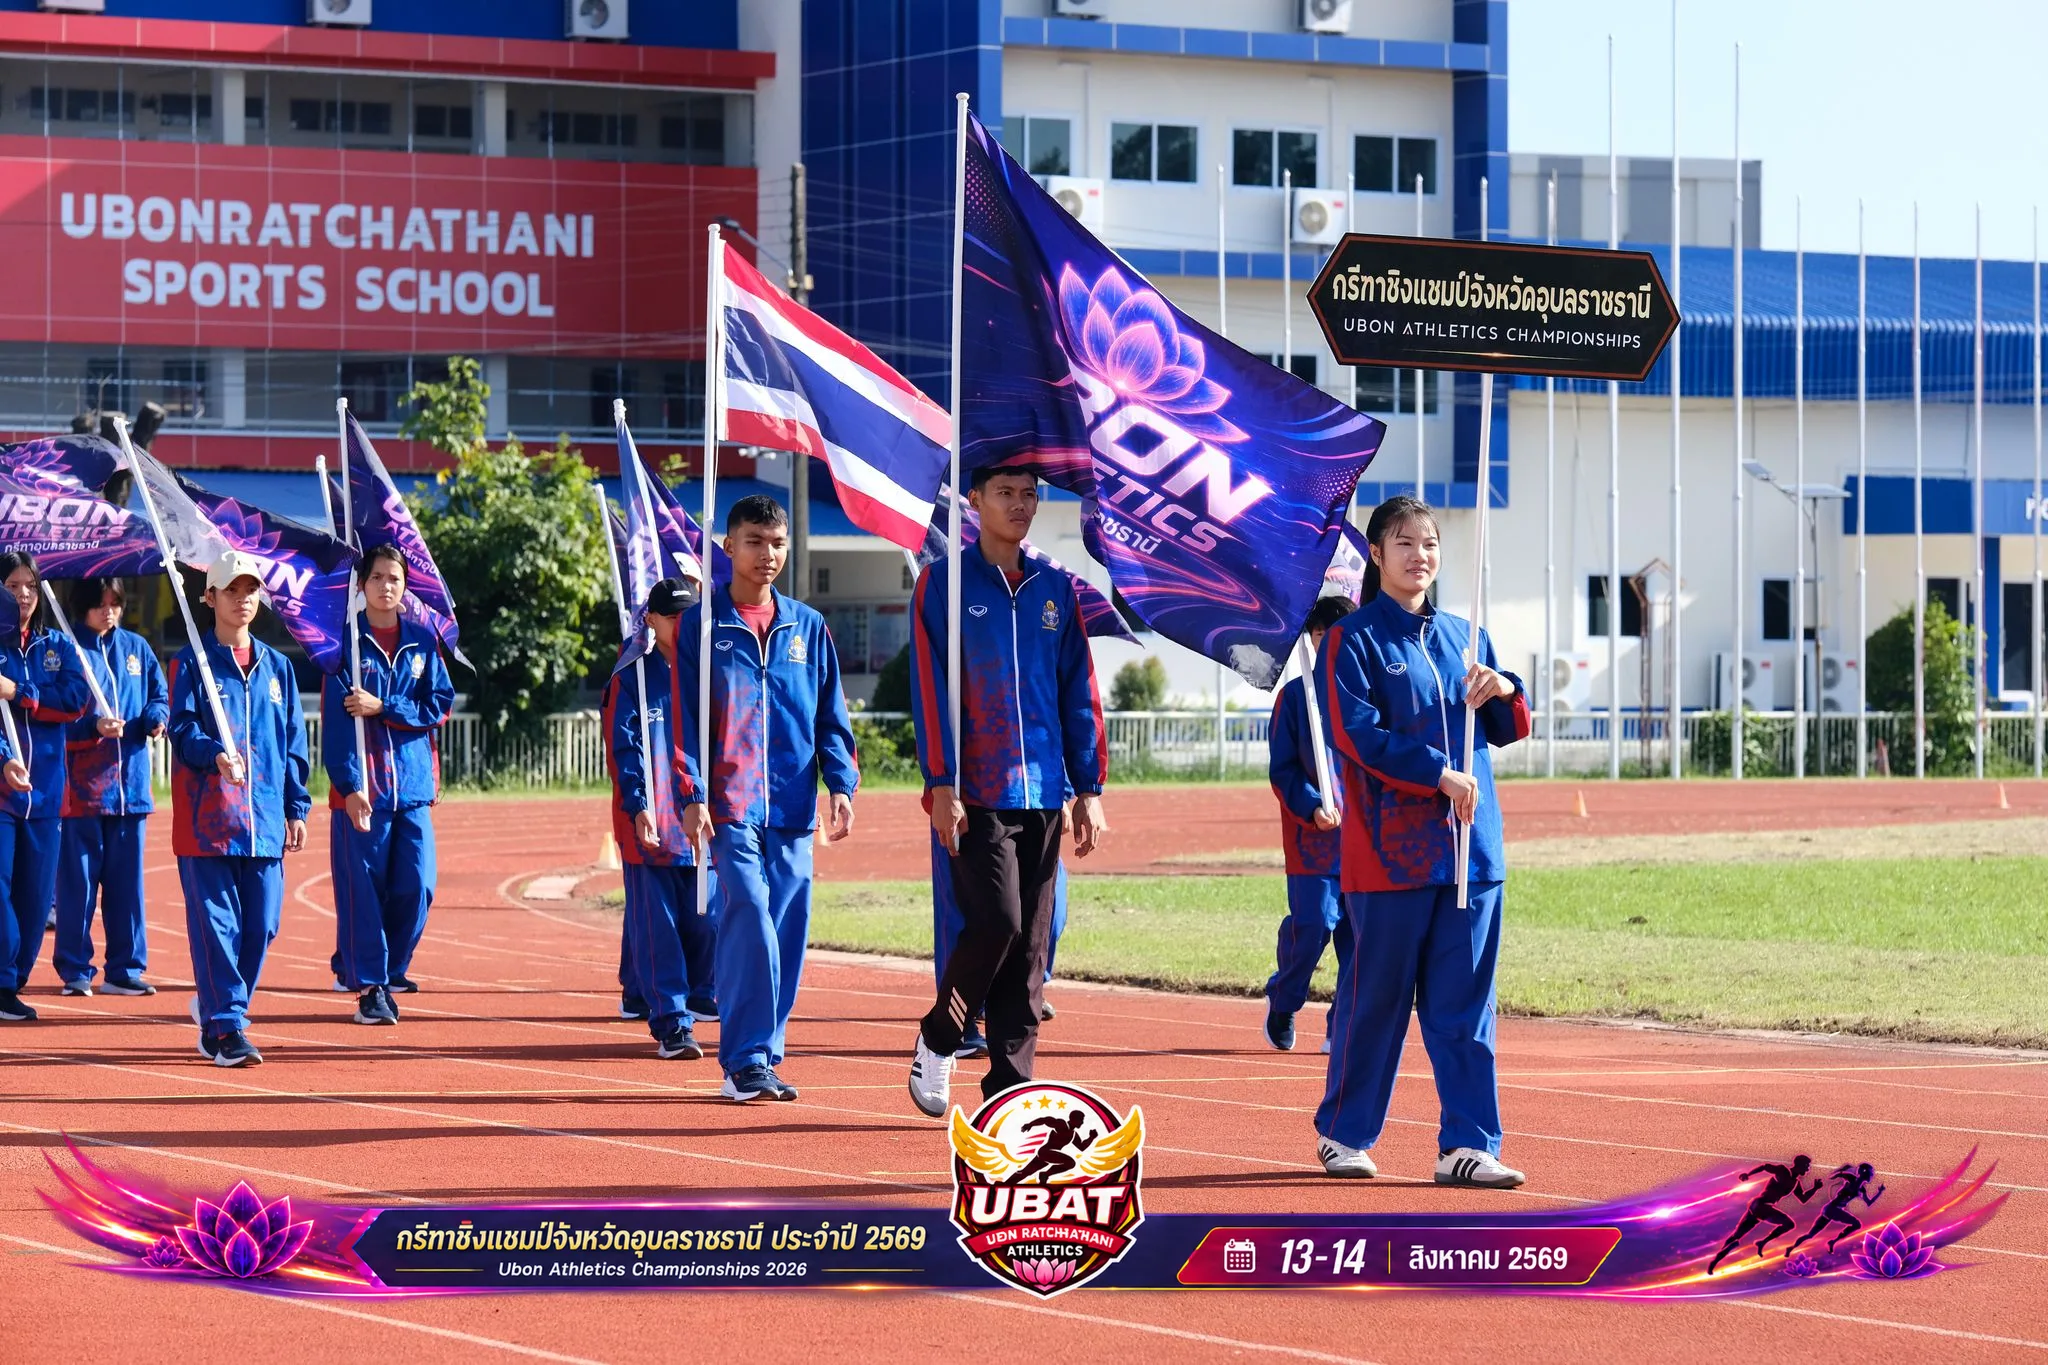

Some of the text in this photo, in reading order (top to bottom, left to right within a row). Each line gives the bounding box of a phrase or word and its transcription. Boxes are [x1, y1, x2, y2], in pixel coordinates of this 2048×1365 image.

[60, 192, 594, 259] UBONRATCHATHANI
[123, 257, 555, 318] SPORTS SCHOOL
[1344, 318, 1642, 349] UBON ATHLETICS CHAMPIONSHIPS
[1068, 358, 1276, 524] BON
[0, 493, 133, 525] BON
